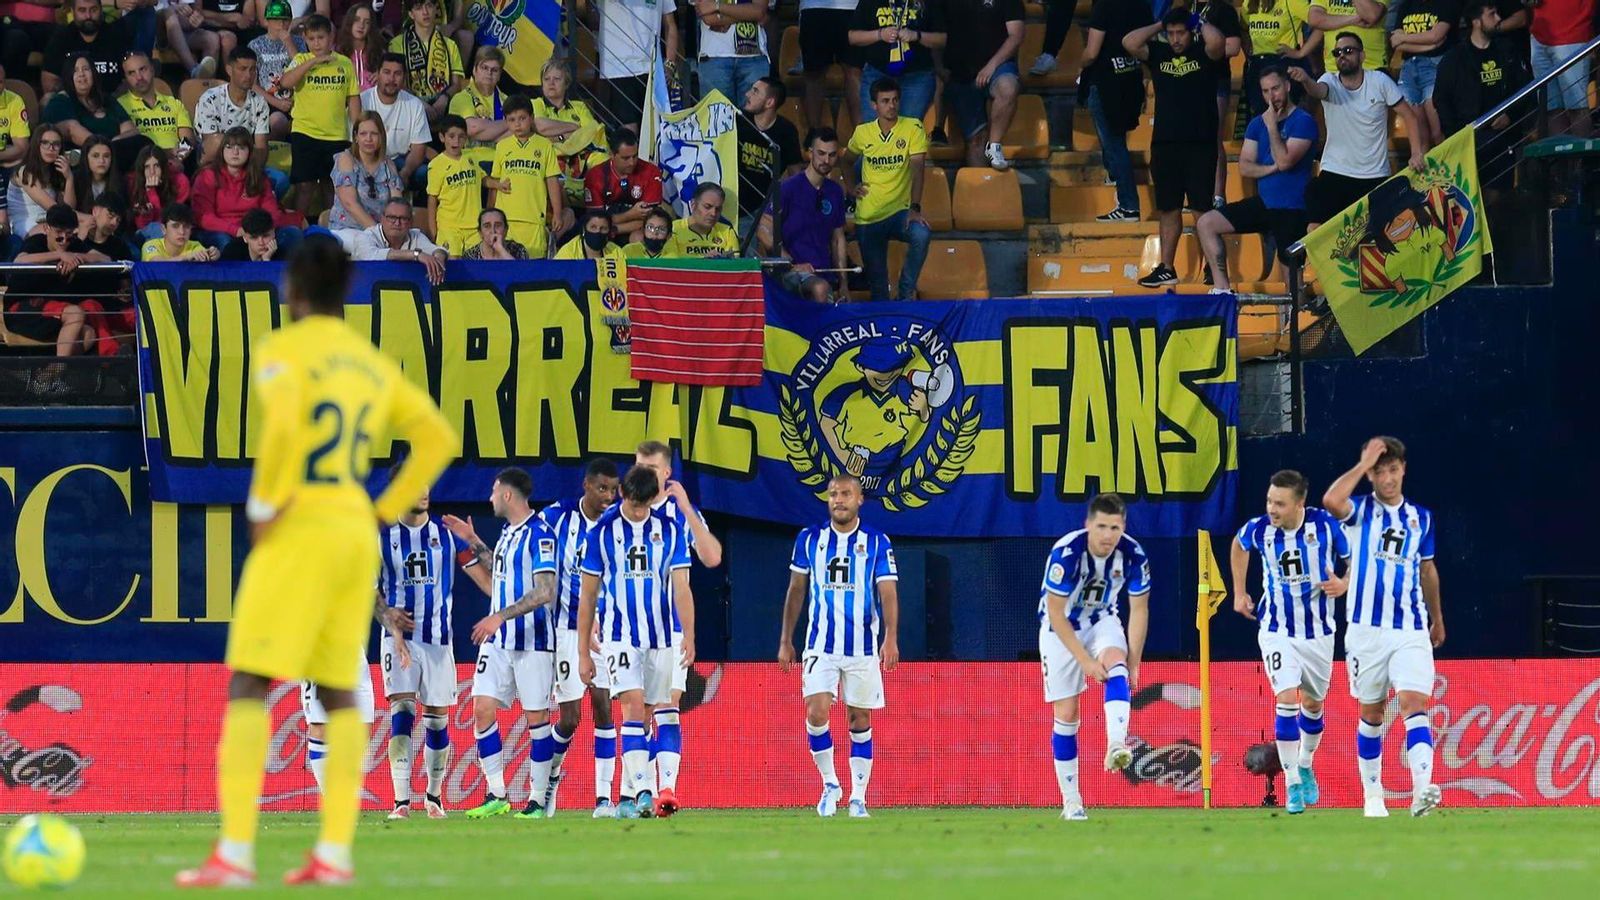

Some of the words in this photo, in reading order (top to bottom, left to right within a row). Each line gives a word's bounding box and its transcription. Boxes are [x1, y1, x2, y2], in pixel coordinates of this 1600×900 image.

[486, 18, 517, 55] TOUR
[1248, 20, 1280, 30] AMESA
[307, 75, 346, 85] PAMESA
[135, 116, 176, 127] PAMESA
[504, 158, 541, 170] PAMESA
[796, 322, 883, 391] VILLARREAL
[907, 323, 949, 365] FANS
[1010, 324, 1221, 494] FANS
[304, 400, 372, 484] 26
[859, 475, 883, 491] 2017
[1381, 527, 1405, 555] fi
[404, 552, 427, 578] fi
[626, 545, 648, 571] fi
[827, 557, 850, 583] fi
[1278, 550, 1302, 576] fi
[384, 653, 392, 672] 8
[477, 654, 489, 675] 5
[607, 651, 631, 675] 24
[1265, 651, 1282, 673] 18
